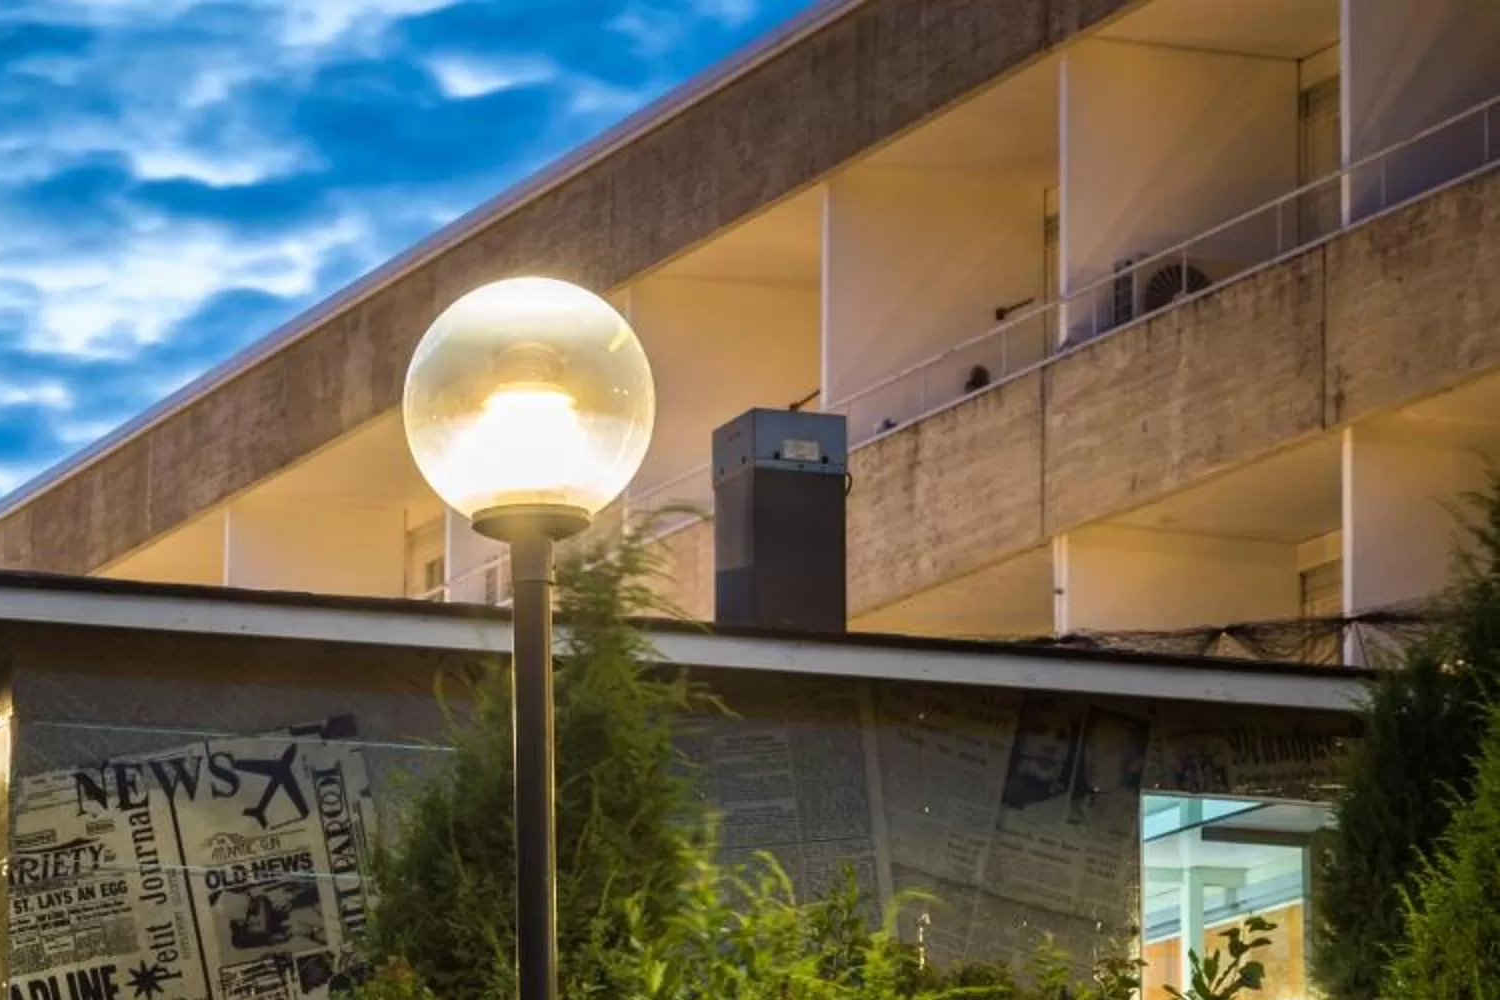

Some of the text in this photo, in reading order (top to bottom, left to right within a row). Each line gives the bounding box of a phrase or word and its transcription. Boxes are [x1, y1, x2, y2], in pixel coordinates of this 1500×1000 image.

[73, 746, 241, 816] NEWS
[250, 852, 316, 881] NEWS
[37, 890, 74, 910] LAYS
[100, 879, 129, 898] EGG
